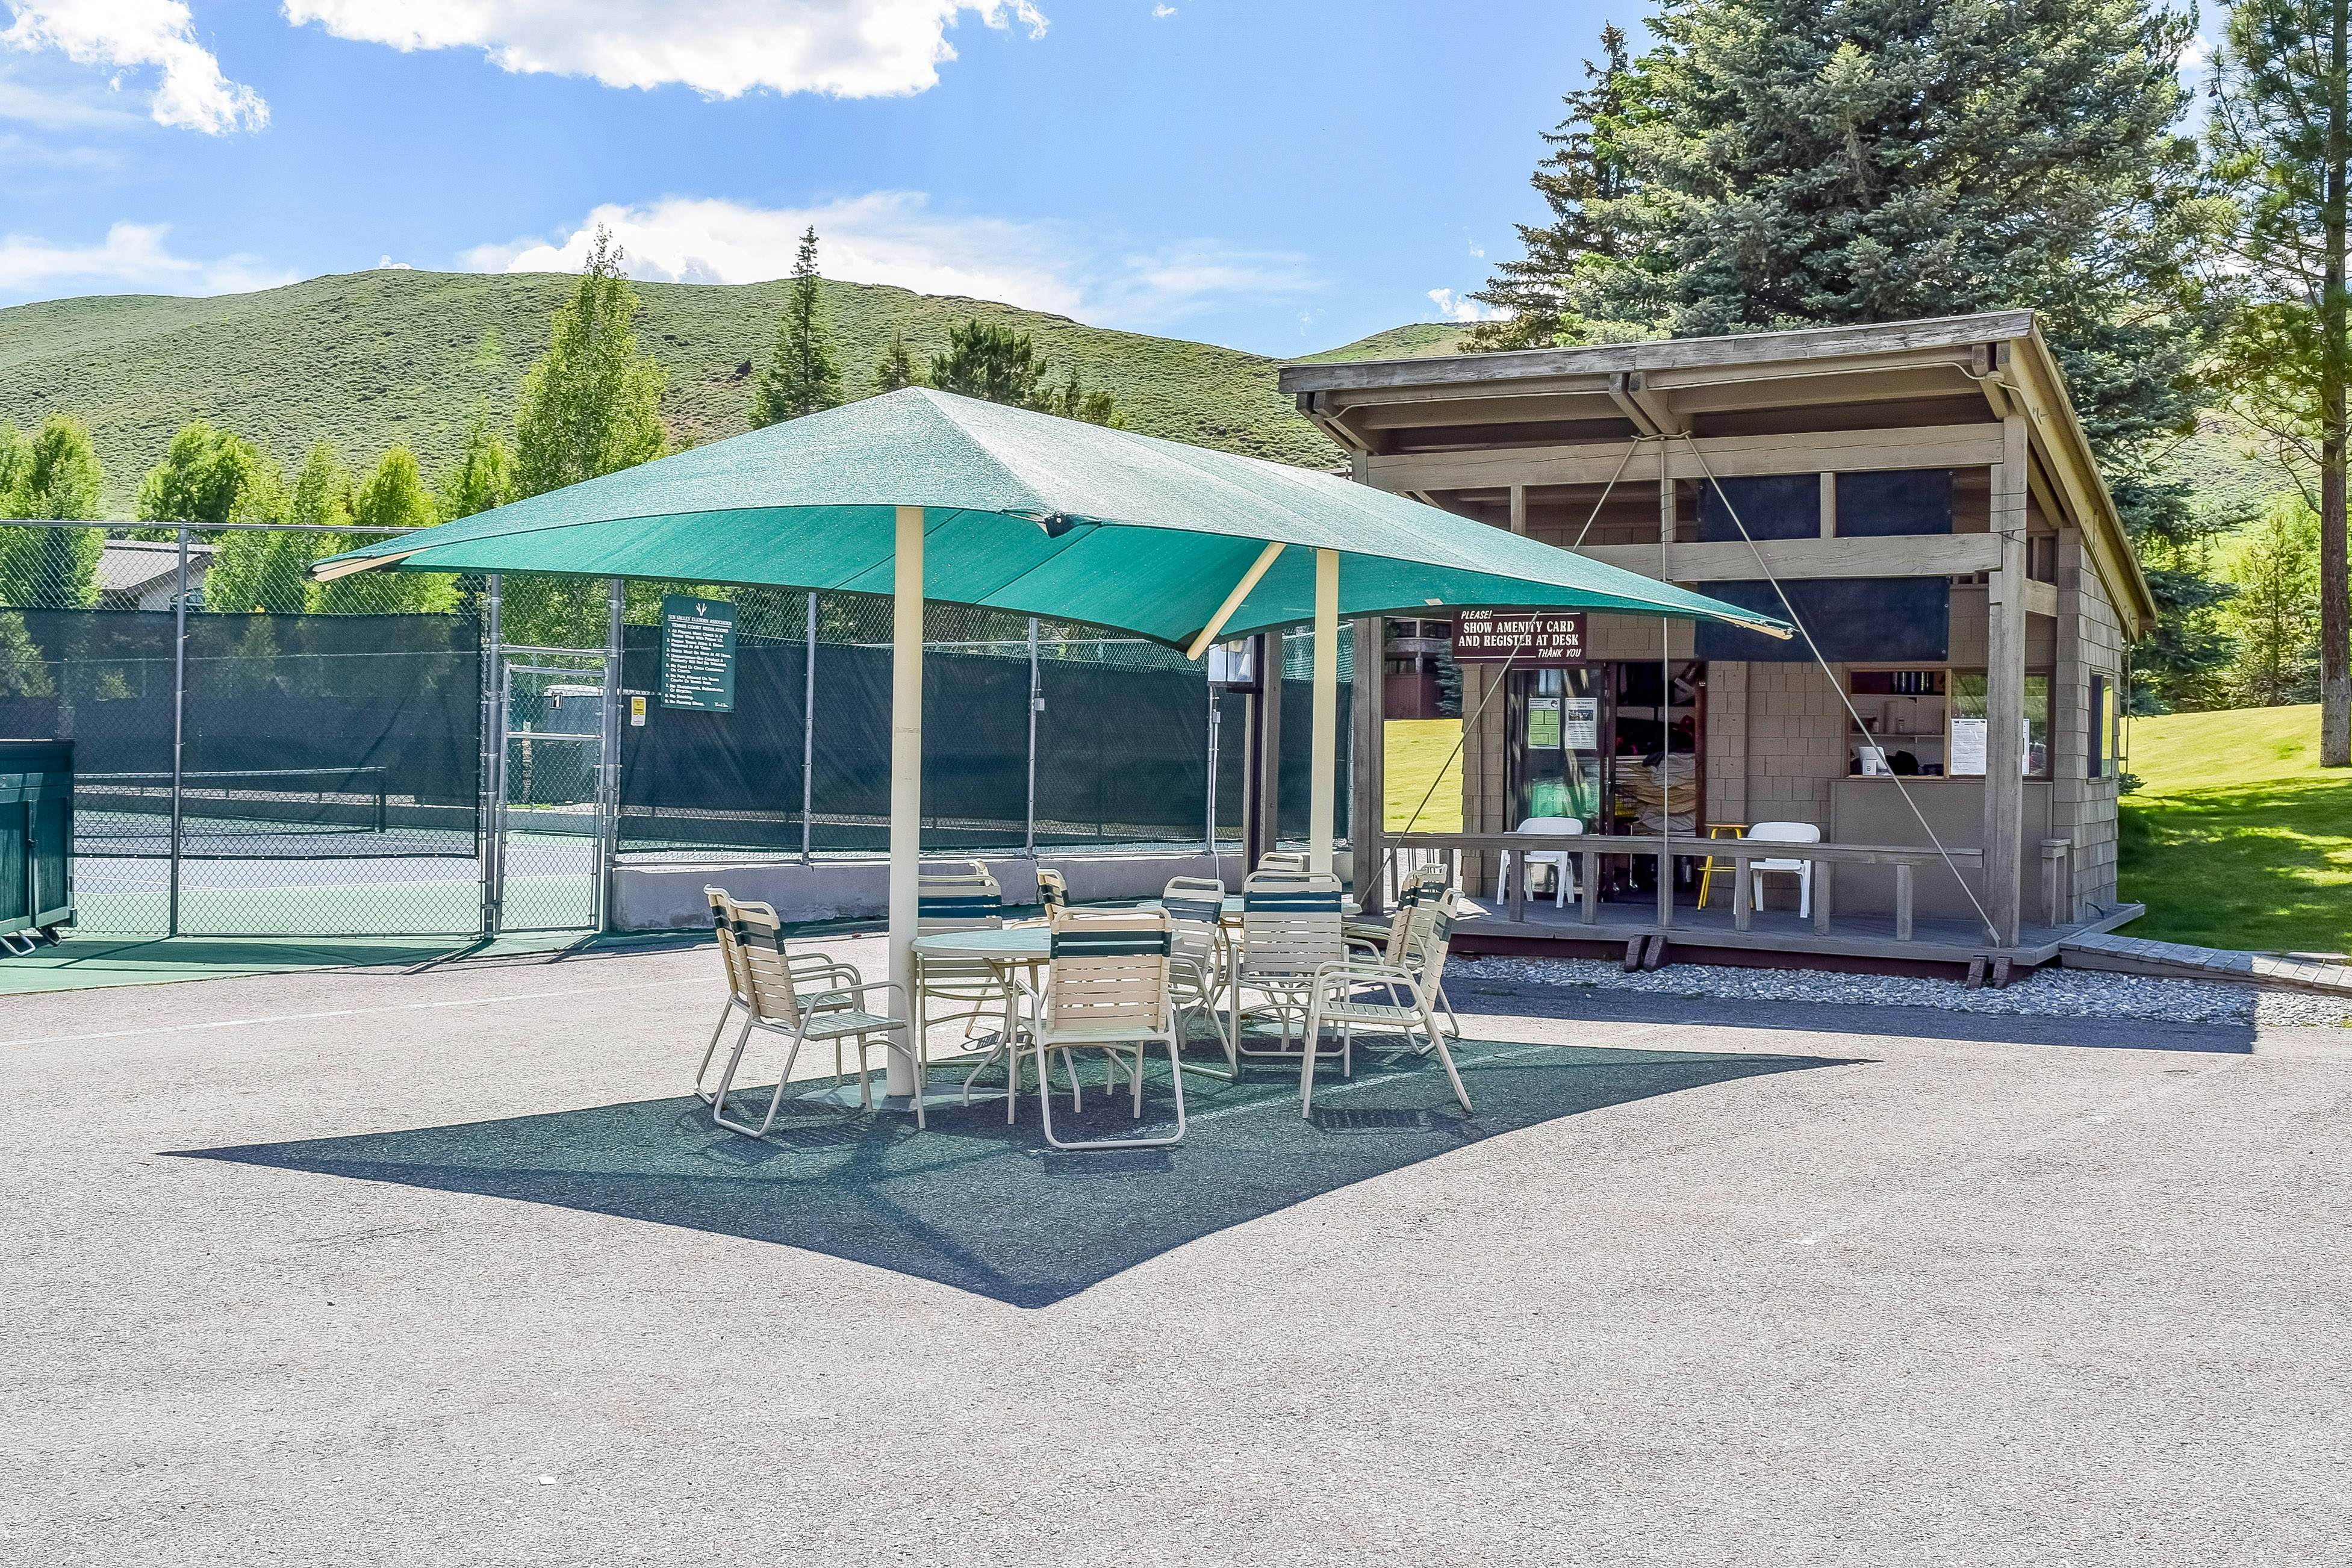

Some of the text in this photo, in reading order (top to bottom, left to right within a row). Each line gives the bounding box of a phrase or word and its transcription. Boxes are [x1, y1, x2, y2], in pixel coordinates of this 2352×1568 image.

[1461, 611, 1492, 619] PLEASE!
[1463, 621, 1574, 633] SHOW AMENITY CARD
[1458, 634, 1578, 647] AND REGISTER AT DESK
[1538, 649, 1581, 658] THANK YOU
[555, 695, 559, 707] 1
